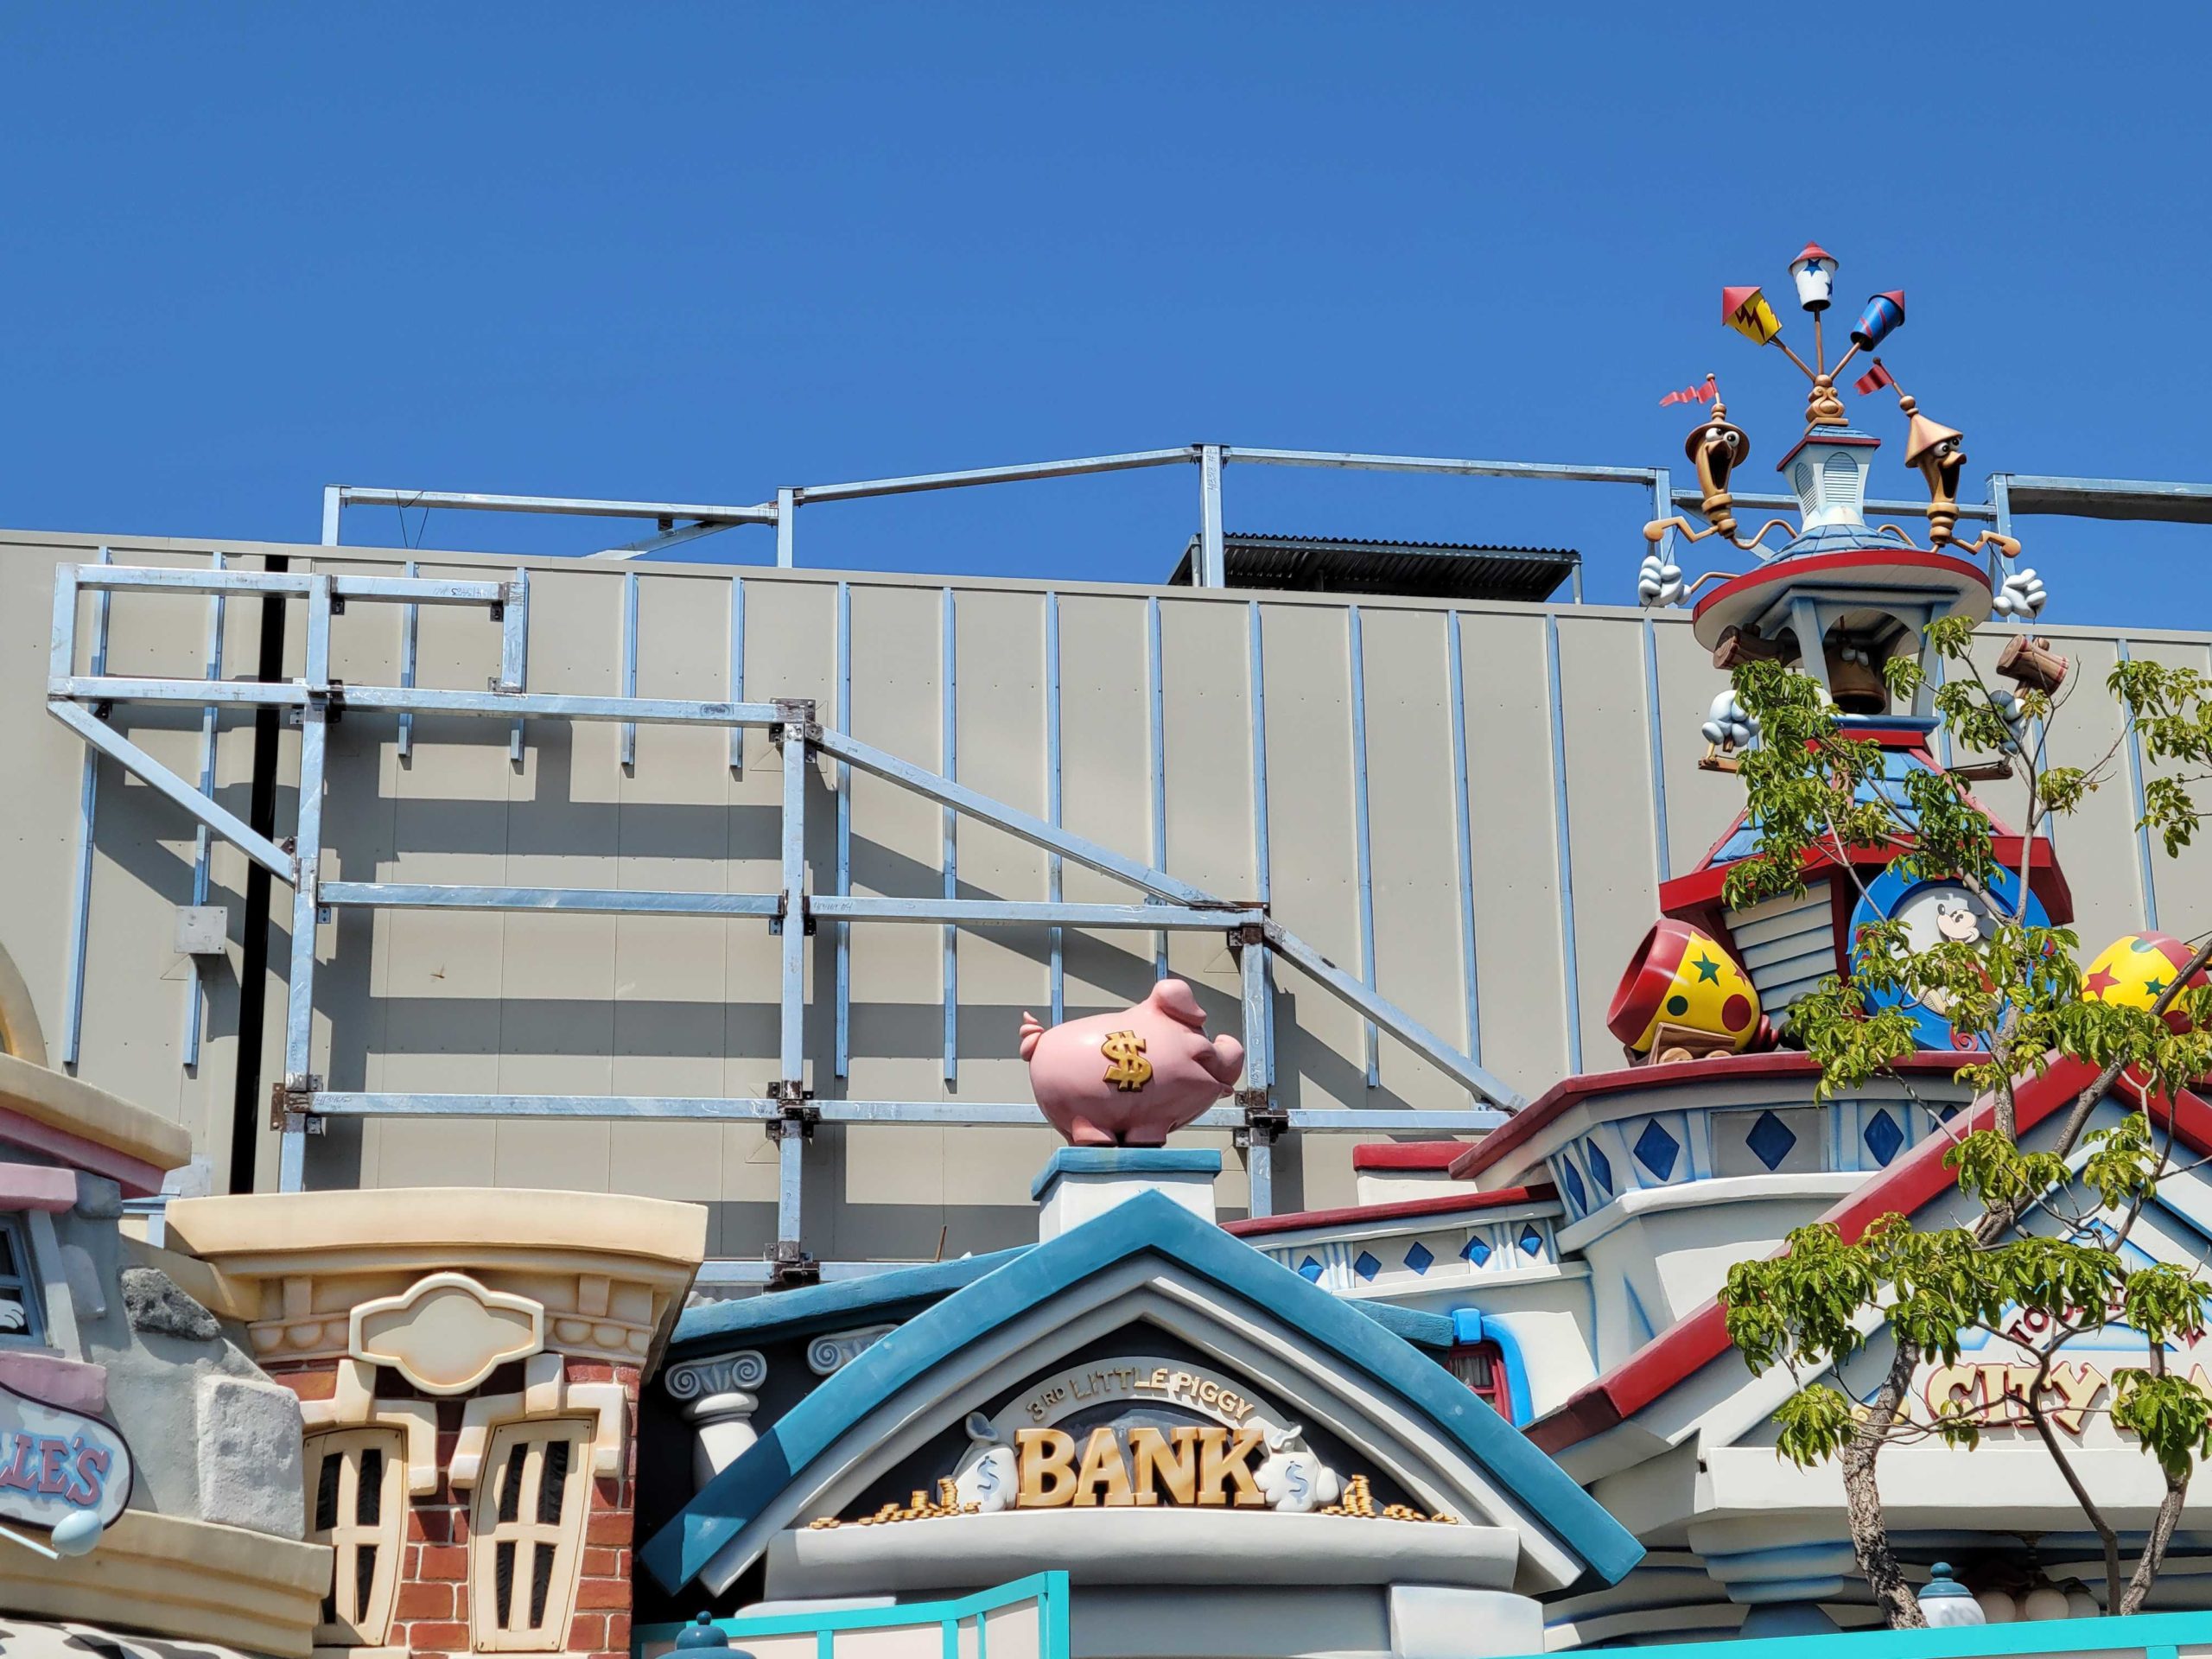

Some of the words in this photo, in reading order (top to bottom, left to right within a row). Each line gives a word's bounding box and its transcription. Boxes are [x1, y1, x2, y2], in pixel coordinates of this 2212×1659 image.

[1101, 1029, 1154, 1092] $
[1026, 1388, 1066, 1423] 3RD
[1069, 1367, 1168, 1400] LITTLE
[1173, 1370, 1255, 1420] PIGGY
[1924, 1361, 2107, 1434] CITY
[0, 1433, 110, 1507] LE'S
[1014, 1427, 1267, 1508] BANK
